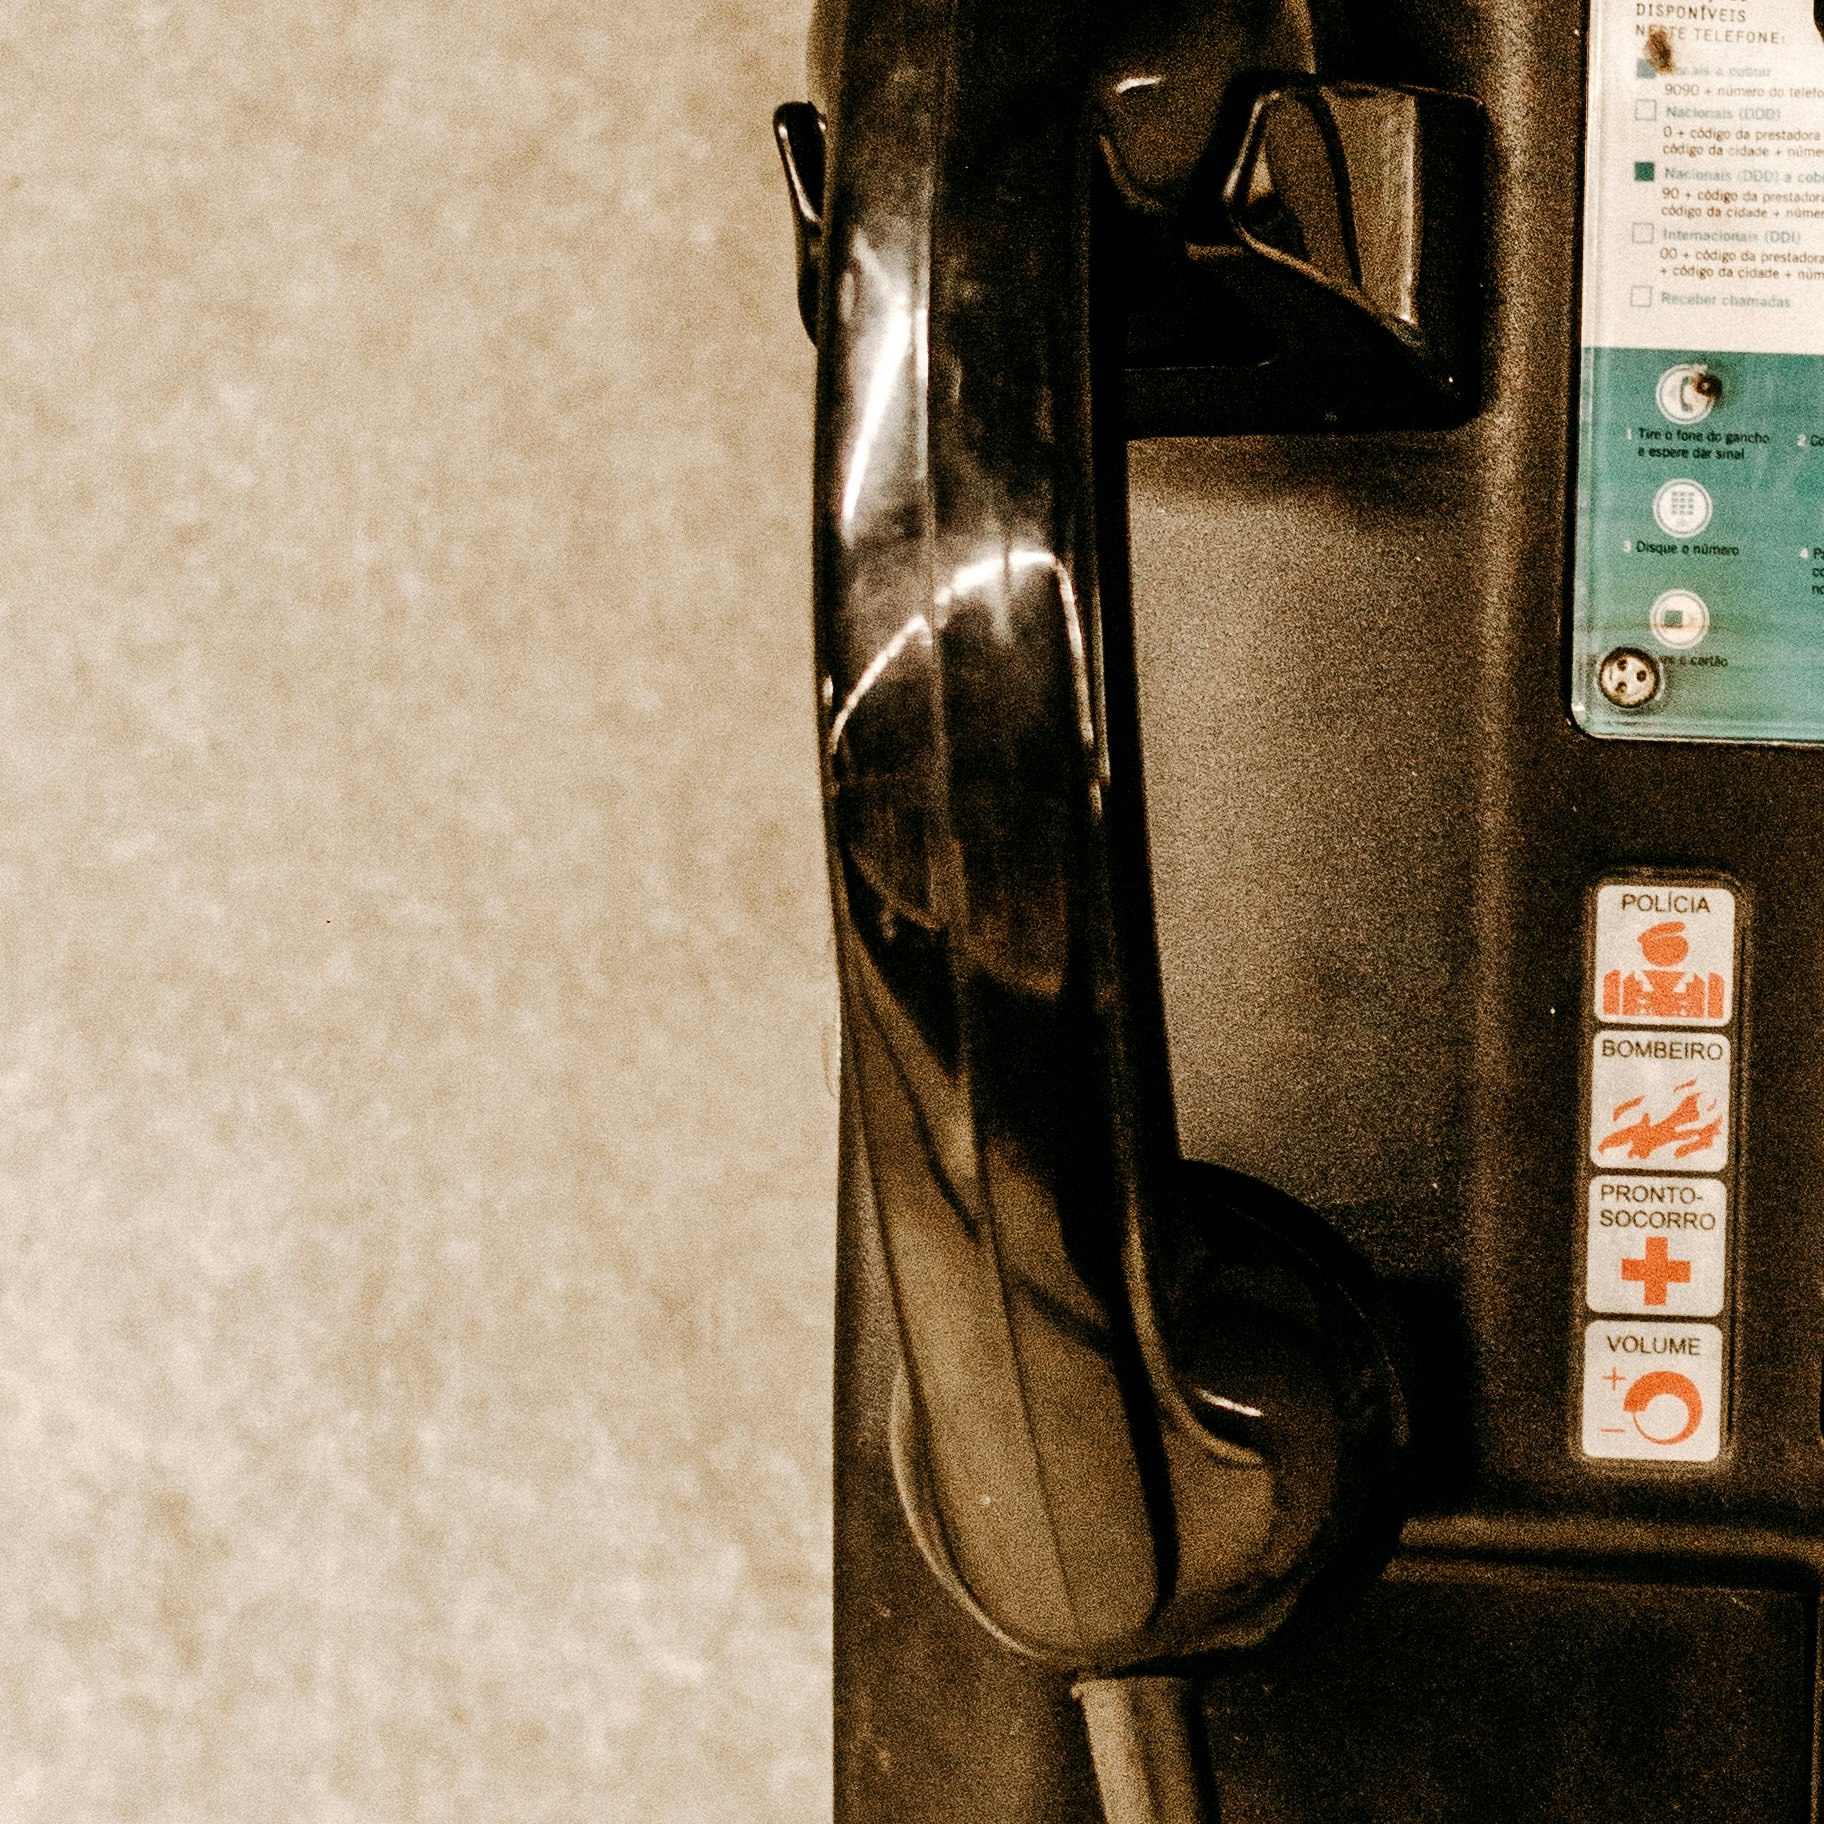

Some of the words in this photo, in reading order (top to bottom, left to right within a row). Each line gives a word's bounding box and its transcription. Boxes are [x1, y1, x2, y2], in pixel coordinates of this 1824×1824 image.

[1636, 4, 1745, 22] DISPONÍVEIS
[1636, 25, 1686, 40] NETE
[1636, 540, 1677, 555] Disque
[1622, 892, 1710, 913] POLÍCIA
[1602, 1039, 1723, 1060] BOMBEIRO
[1601, 1184, 1703, 1204] PRONTO-
[1600, 1209, 1715, 1231] SOCORRO
[1607, 1336, 1700, 1356] VOLUME
